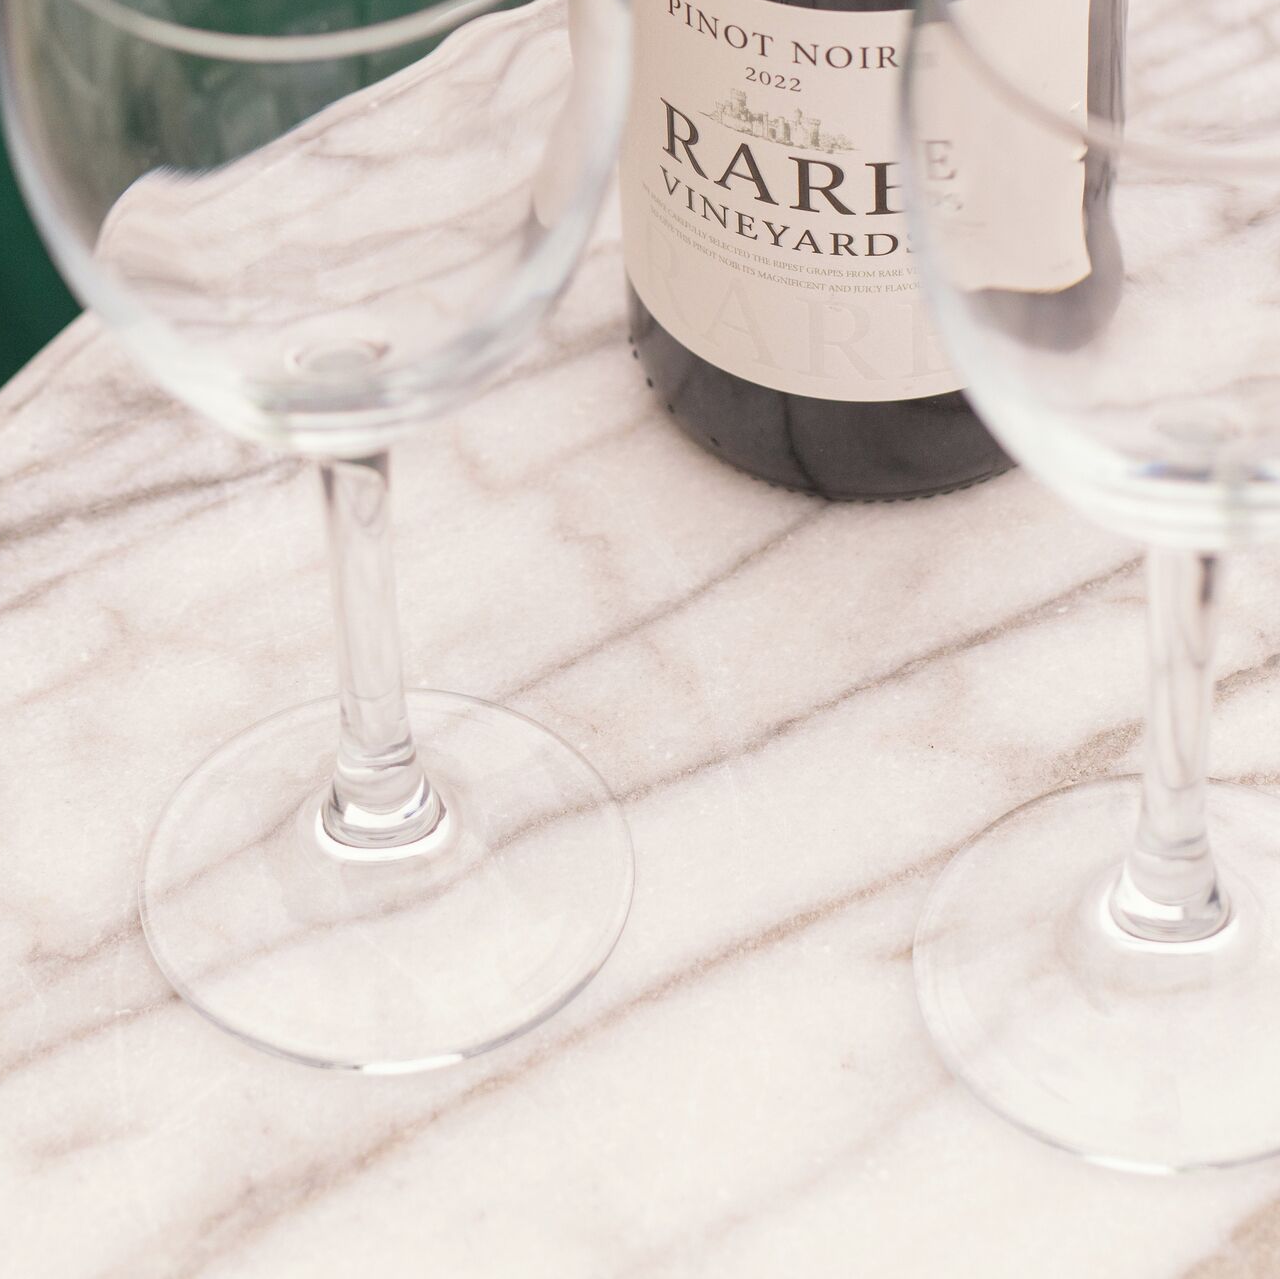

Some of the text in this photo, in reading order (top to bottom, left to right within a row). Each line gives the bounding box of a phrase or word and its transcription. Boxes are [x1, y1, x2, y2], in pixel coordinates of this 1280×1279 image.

[790, 40, 900, 69] NOIR
[745, 66, 802, 93] 2022
[692, 239, 718, 260] PINOT
[718, 254, 741, 272] NOIR
[741, 263, 756, 277] ITS
[757, 269, 826, 292] MAGNIFICENT
[827, 283, 852, 294] AND
[852, 283, 883, 295] JUICY
[709, 235, 751, 260] SELECTED
[752, 252, 771, 267] THE
[772, 259, 805, 273] RIPEST
[806, 266, 845, 278] GRAPES
[845, 269, 877, 279] FROM
[878, 268, 905, 279] RARE
